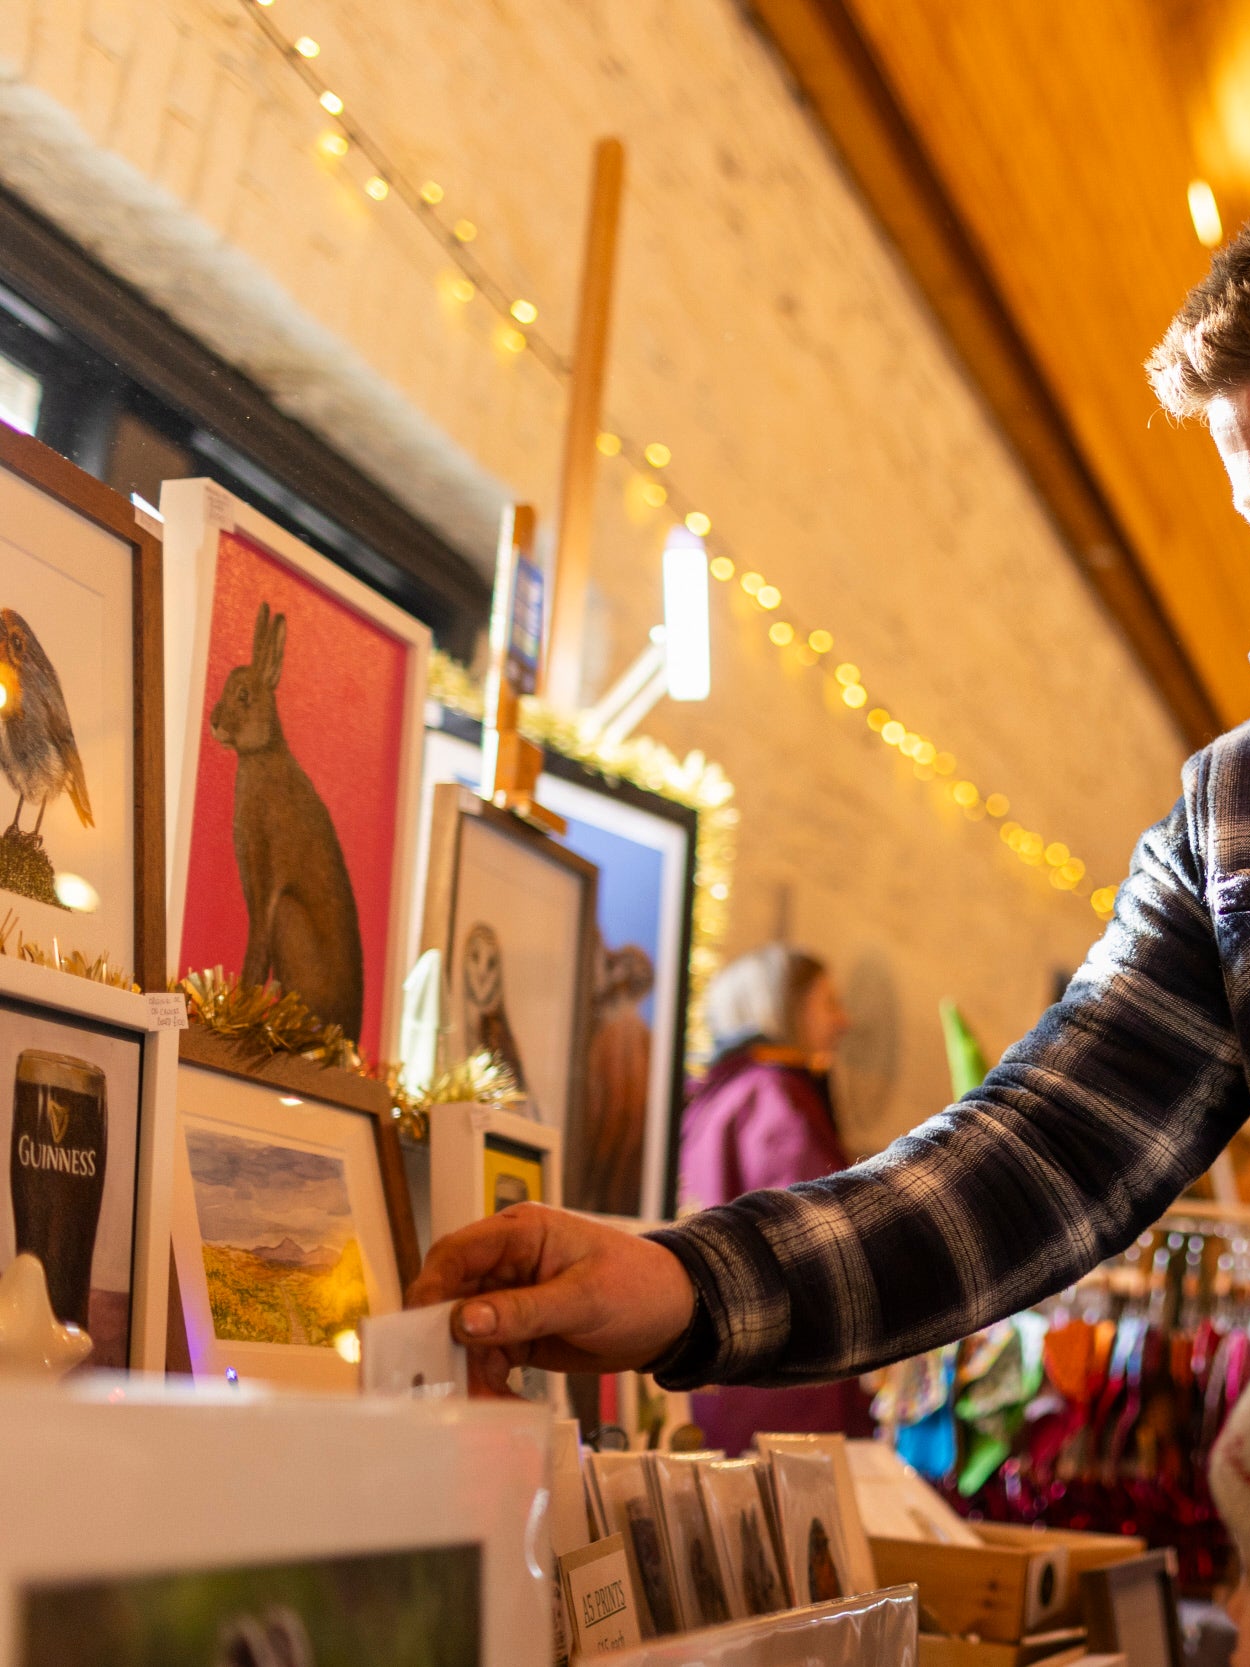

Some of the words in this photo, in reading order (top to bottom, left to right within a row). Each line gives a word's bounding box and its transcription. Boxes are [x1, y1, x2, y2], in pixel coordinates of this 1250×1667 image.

[18, 1134, 96, 1177] GUINNESS
[582, 1594, 595, 1624] A5
[594, 1579, 626, 1618] PRINTS
